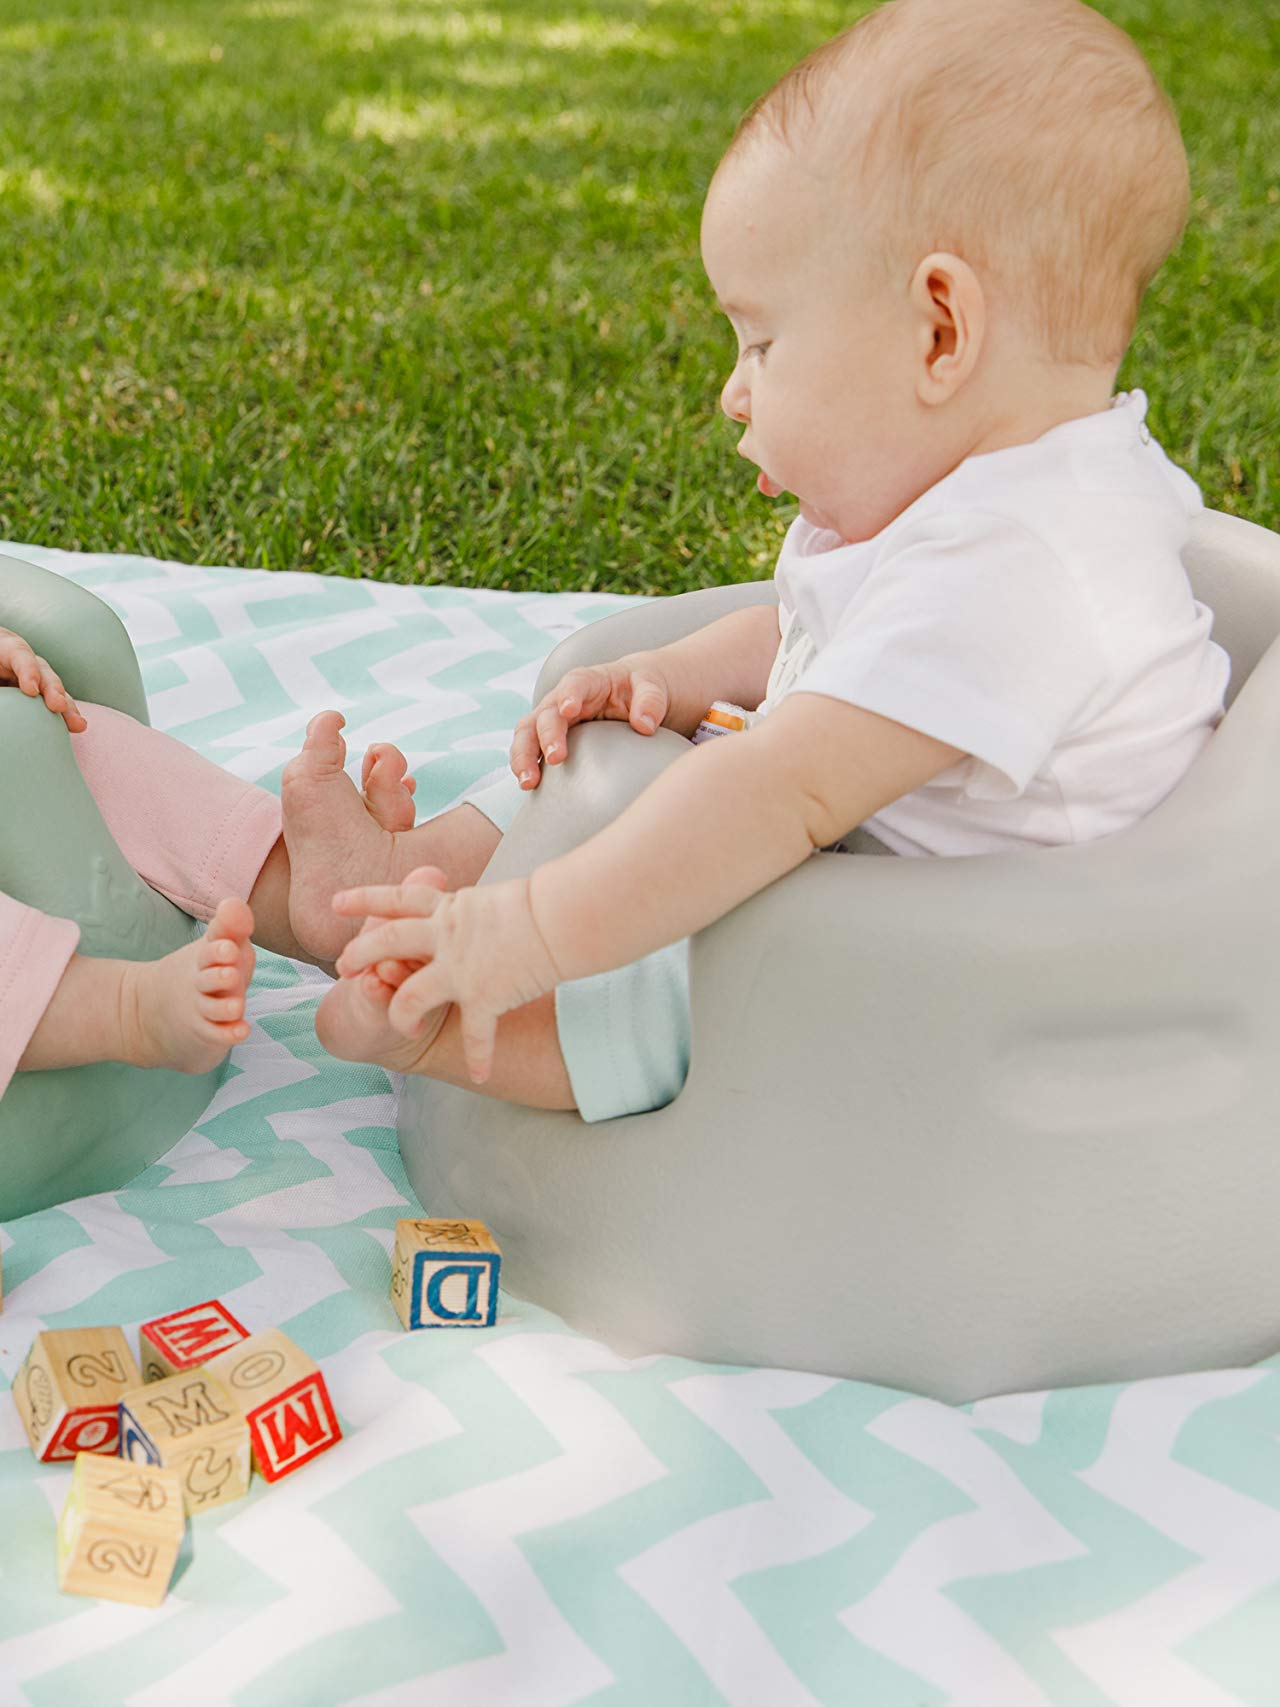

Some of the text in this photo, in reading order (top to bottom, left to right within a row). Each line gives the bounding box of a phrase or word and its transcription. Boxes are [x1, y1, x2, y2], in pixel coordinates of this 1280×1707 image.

[425, 1264, 486, 1321] D
[66, 1350, 128, 1388] 2
[147, 1381, 231, 1439] M
[86, 1537, 158, 1579] 2
